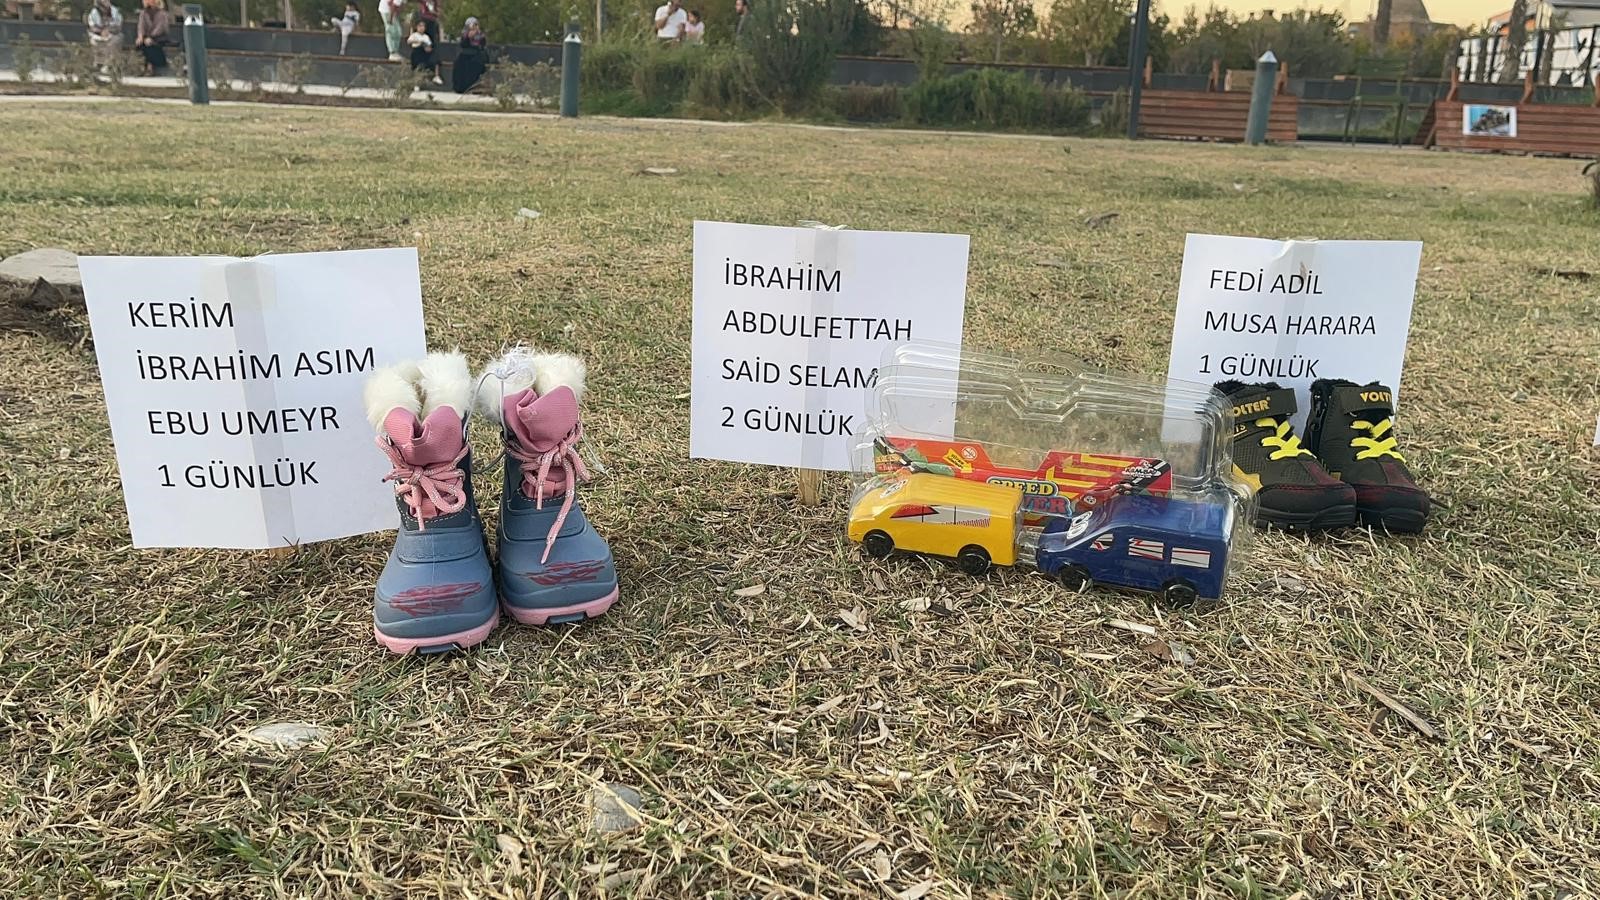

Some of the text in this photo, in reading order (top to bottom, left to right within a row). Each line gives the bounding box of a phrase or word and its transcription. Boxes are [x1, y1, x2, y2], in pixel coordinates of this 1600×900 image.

[725, 257, 841, 293] İBRAHİM
[1209, 268, 1324, 295] FEDİ ADİL
[128, 296, 234, 328] KERİM
[722, 309, 912, 342] ABDULFETTAH
[1204, 310, 1376, 336] MUSA HARARA
[136, 346, 376, 381] İBRAHİM ASIM
[721, 356, 879, 389] SAİD SELAM
[1199, 352, 1320, 379] 1 GÜNLÜK
[147, 406, 340, 436] EBU UMEYR
[721, 405, 854, 437] 2 GÜNLÜK
[157, 457, 320, 489] 1 GÜNLÜK
